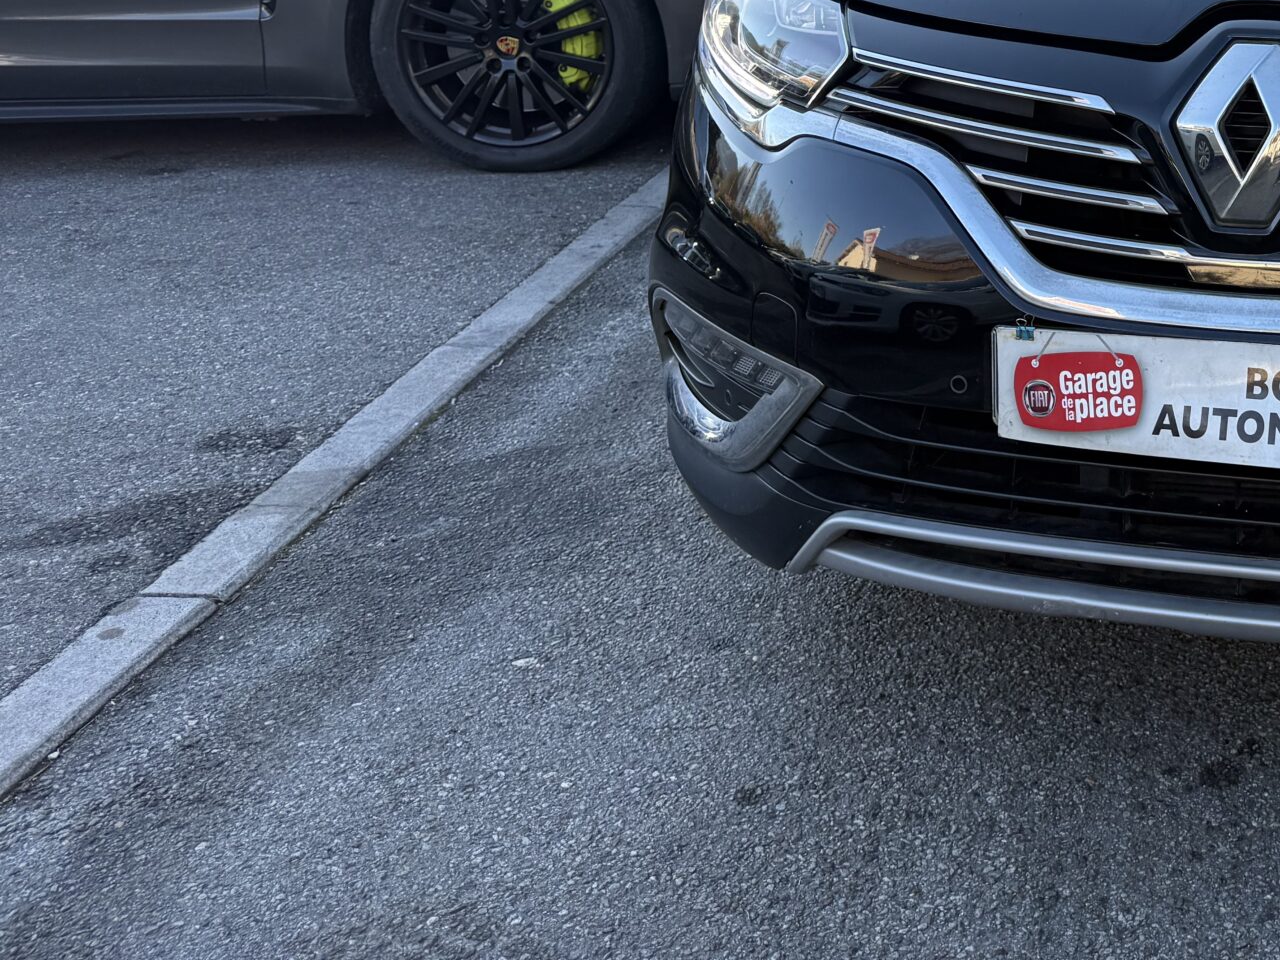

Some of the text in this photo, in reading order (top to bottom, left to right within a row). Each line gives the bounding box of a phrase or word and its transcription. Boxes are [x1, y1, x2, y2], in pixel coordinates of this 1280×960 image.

[1059, 368, 1134, 395] Garage
[1030, 390, 1049, 408] FIAT
[1062, 393, 1136, 423] de place
[1065, 408, 1075, 421] la
